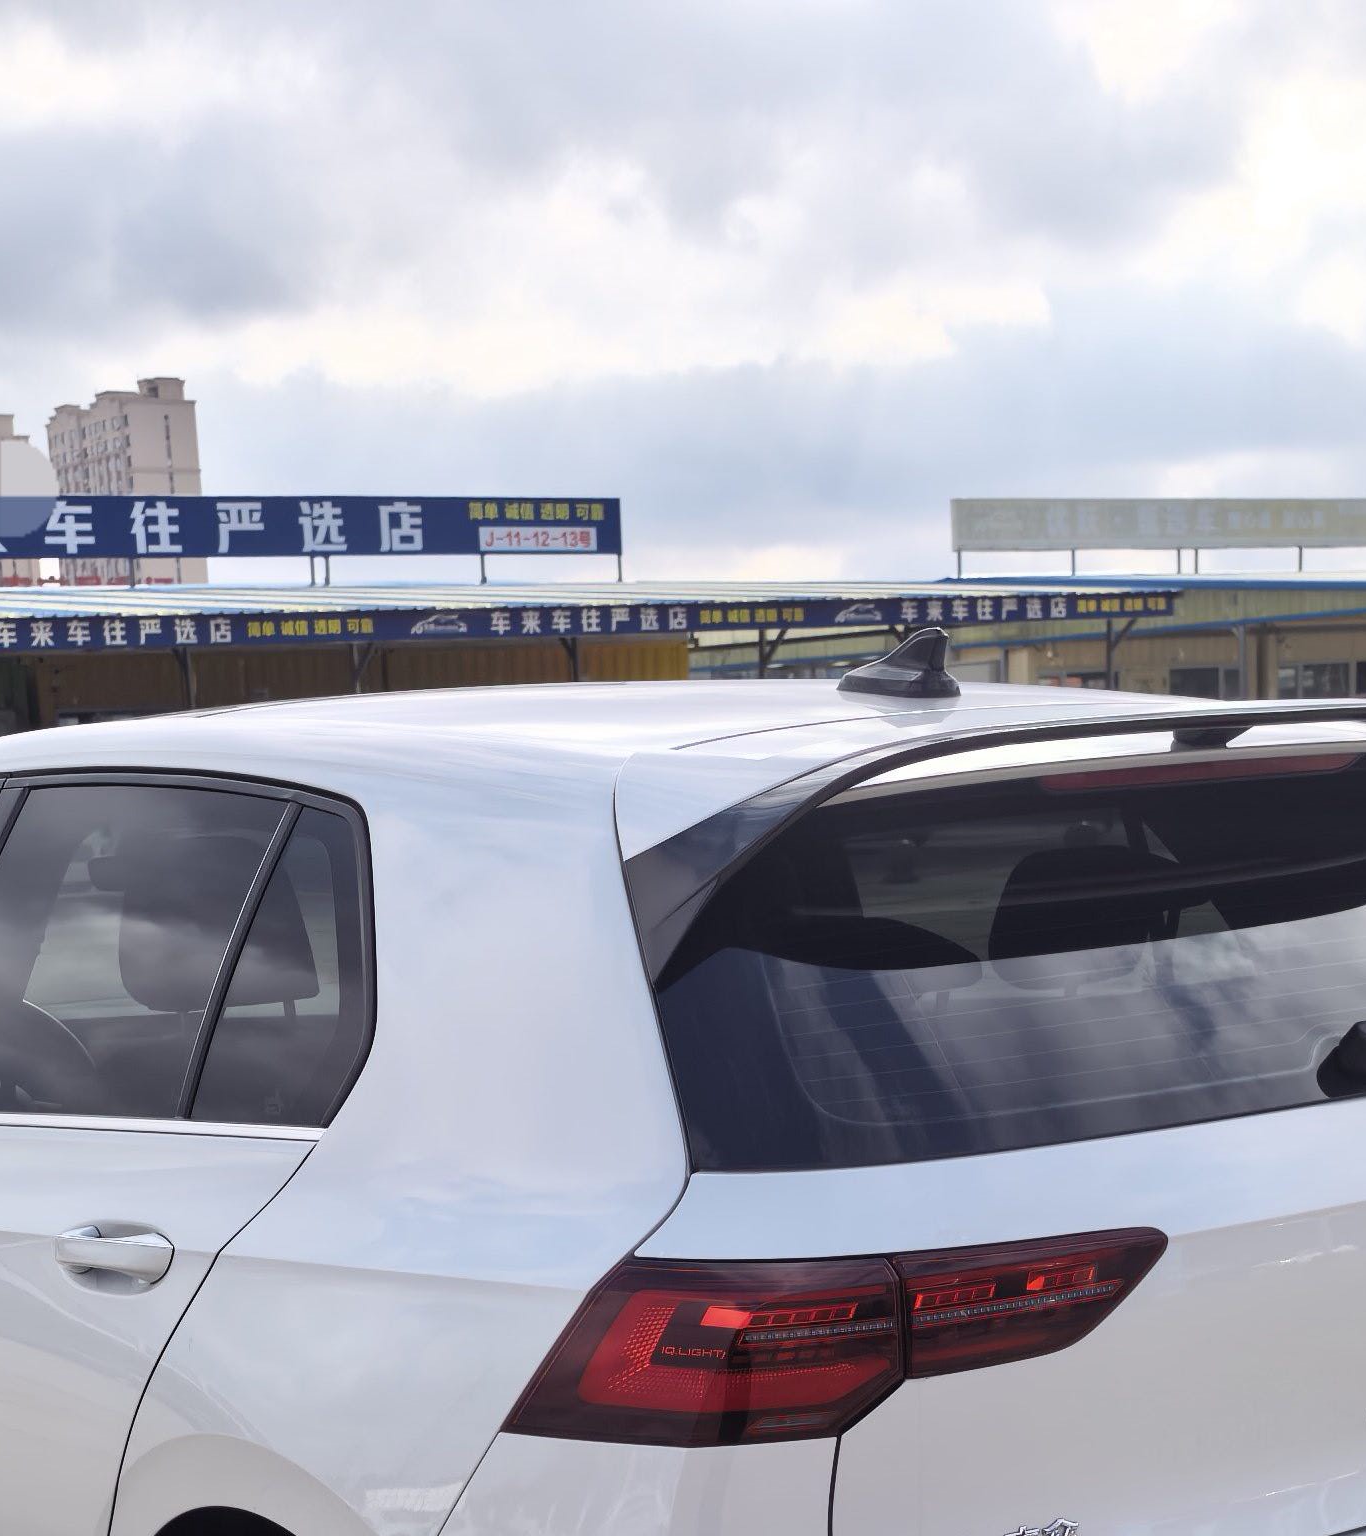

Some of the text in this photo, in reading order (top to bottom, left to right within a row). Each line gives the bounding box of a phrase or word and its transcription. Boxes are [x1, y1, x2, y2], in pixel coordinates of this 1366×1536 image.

[485, 529, 591, 548] J-11-12-13号
[490, 606, 687, 635] 车来车往严选店
